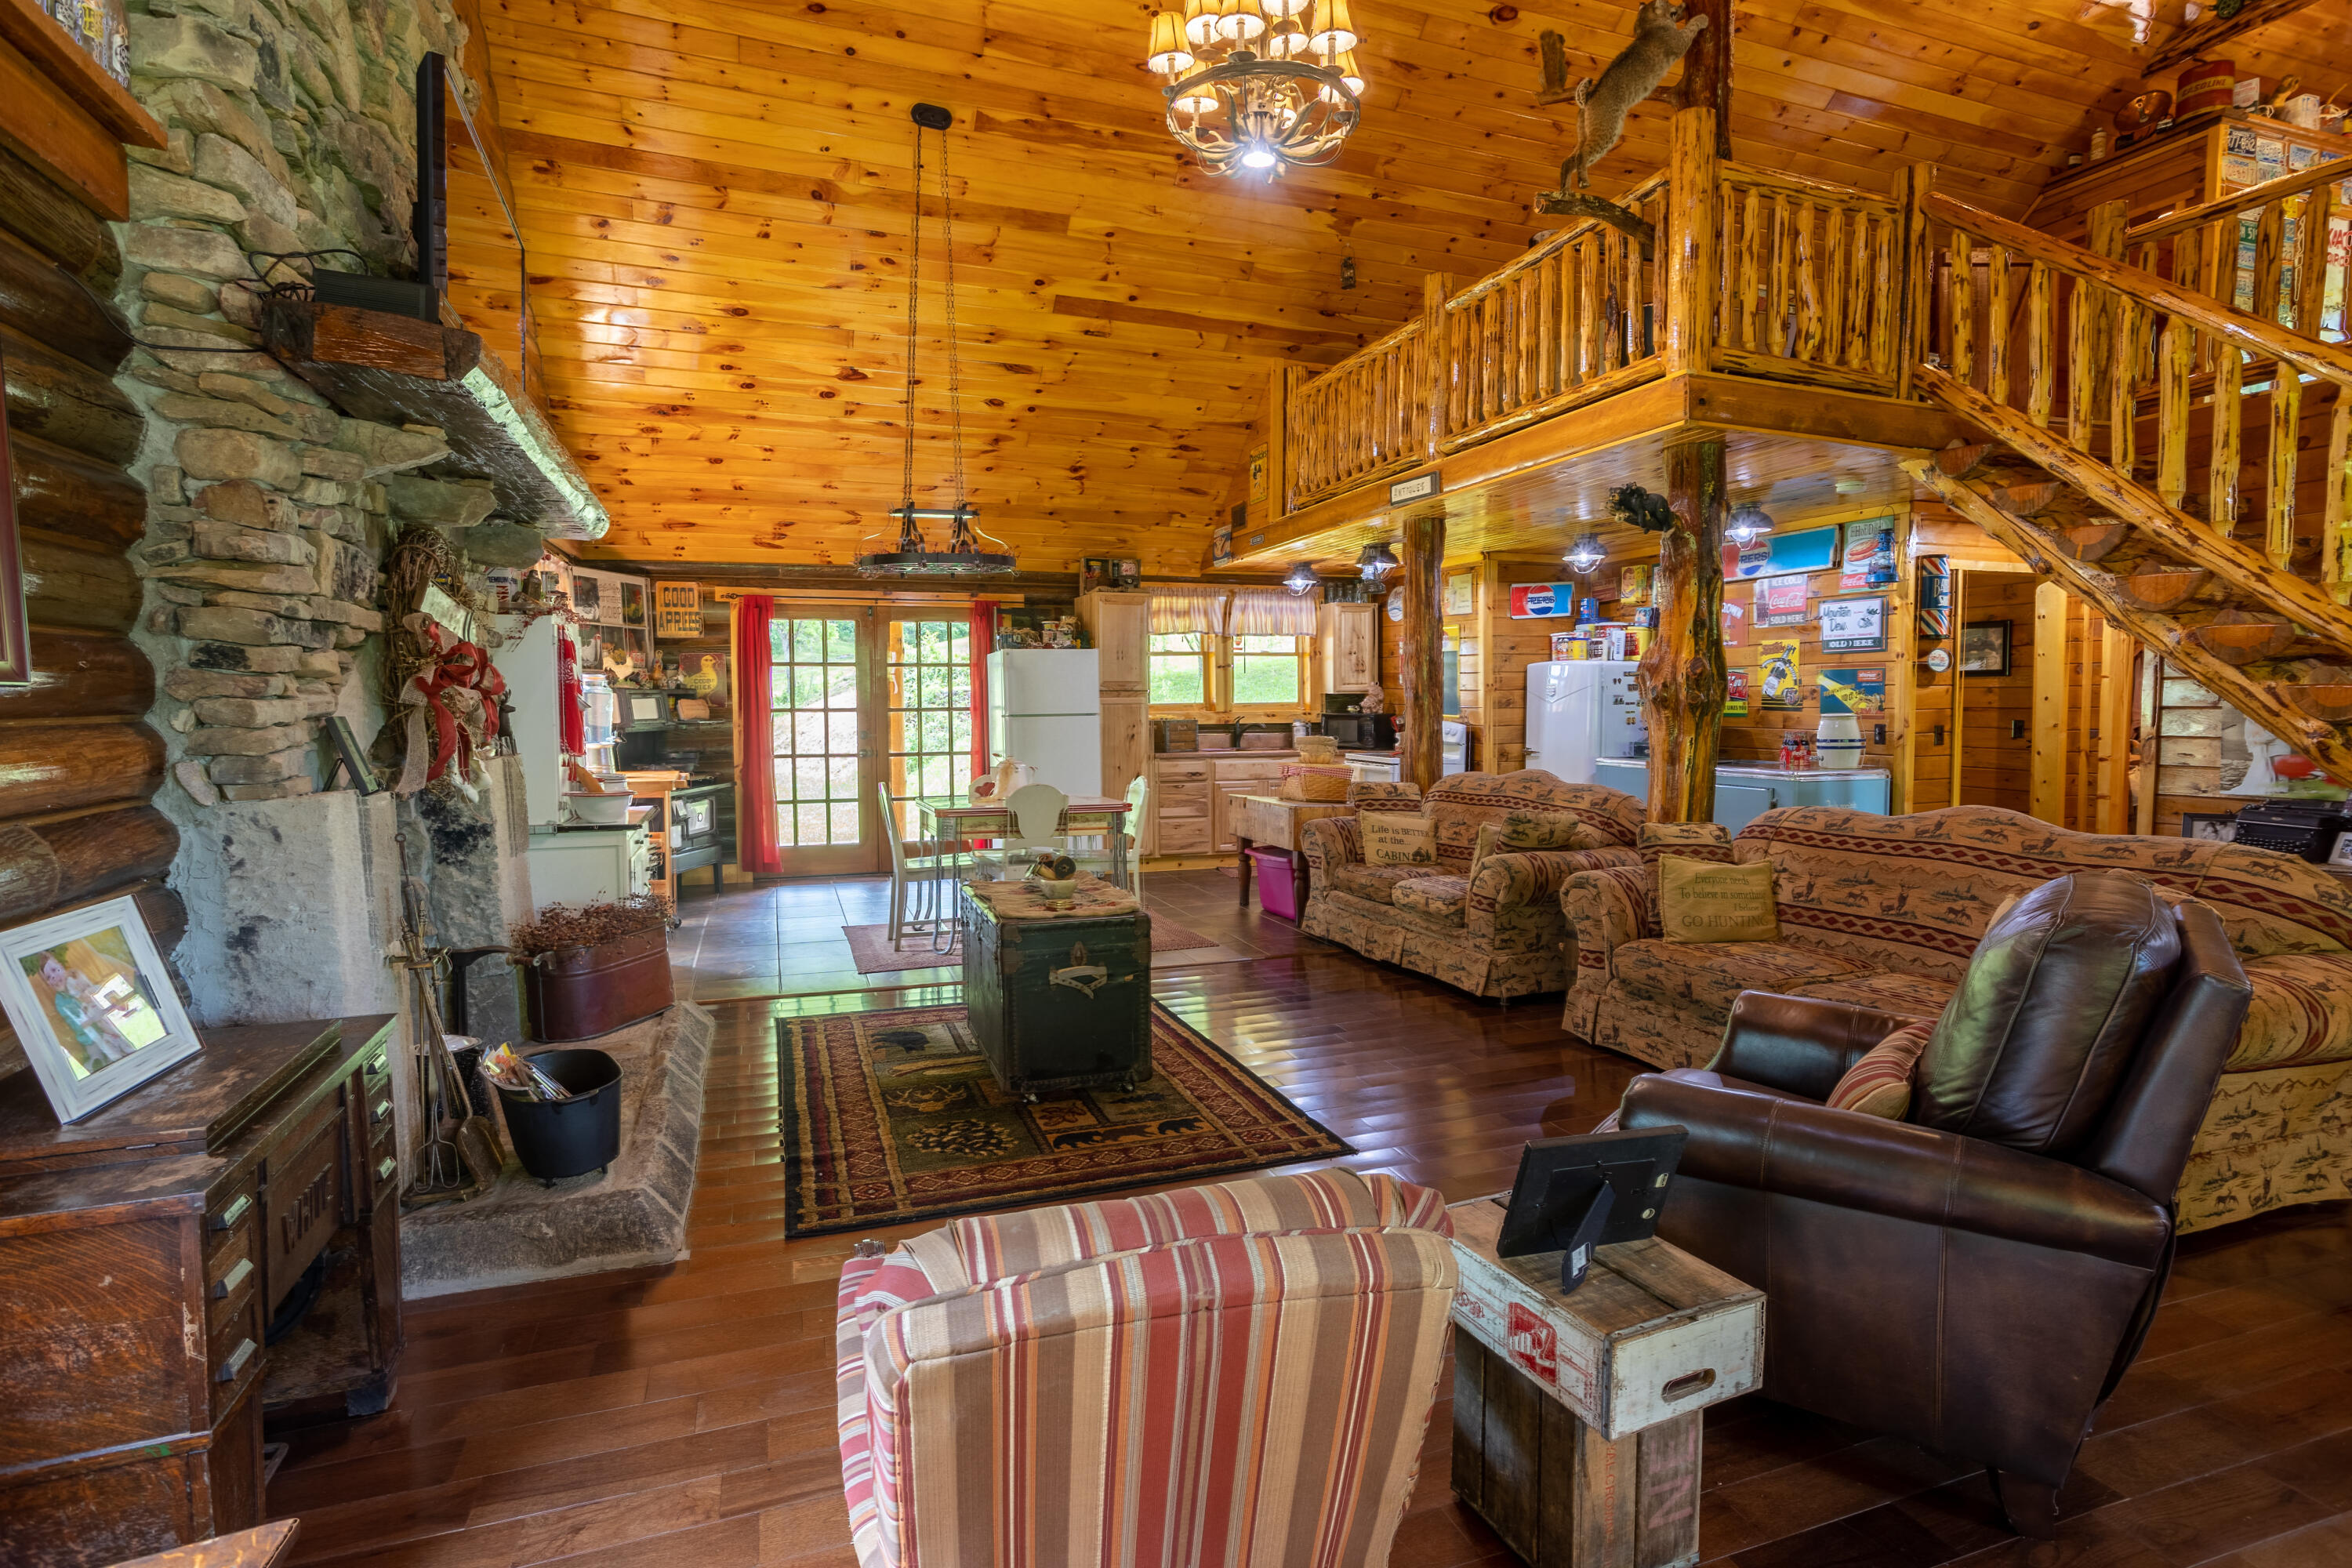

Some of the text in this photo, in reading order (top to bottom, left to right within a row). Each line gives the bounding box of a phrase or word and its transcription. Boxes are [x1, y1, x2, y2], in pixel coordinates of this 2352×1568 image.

[1372, 825, 1431, 837] Life is BETTER
[1377, 836, 1388, 844] at
[1376, 848, 1410, 862] CABIN
[1694, 872, 1750, 887] Everyone needs
[1679, 887, 1691, 899] To
[1693, 887, 1719, 899] believe
[1721, 891, 1729, 899] in
[1682, 915, 1769, 927] GO HUNTING
